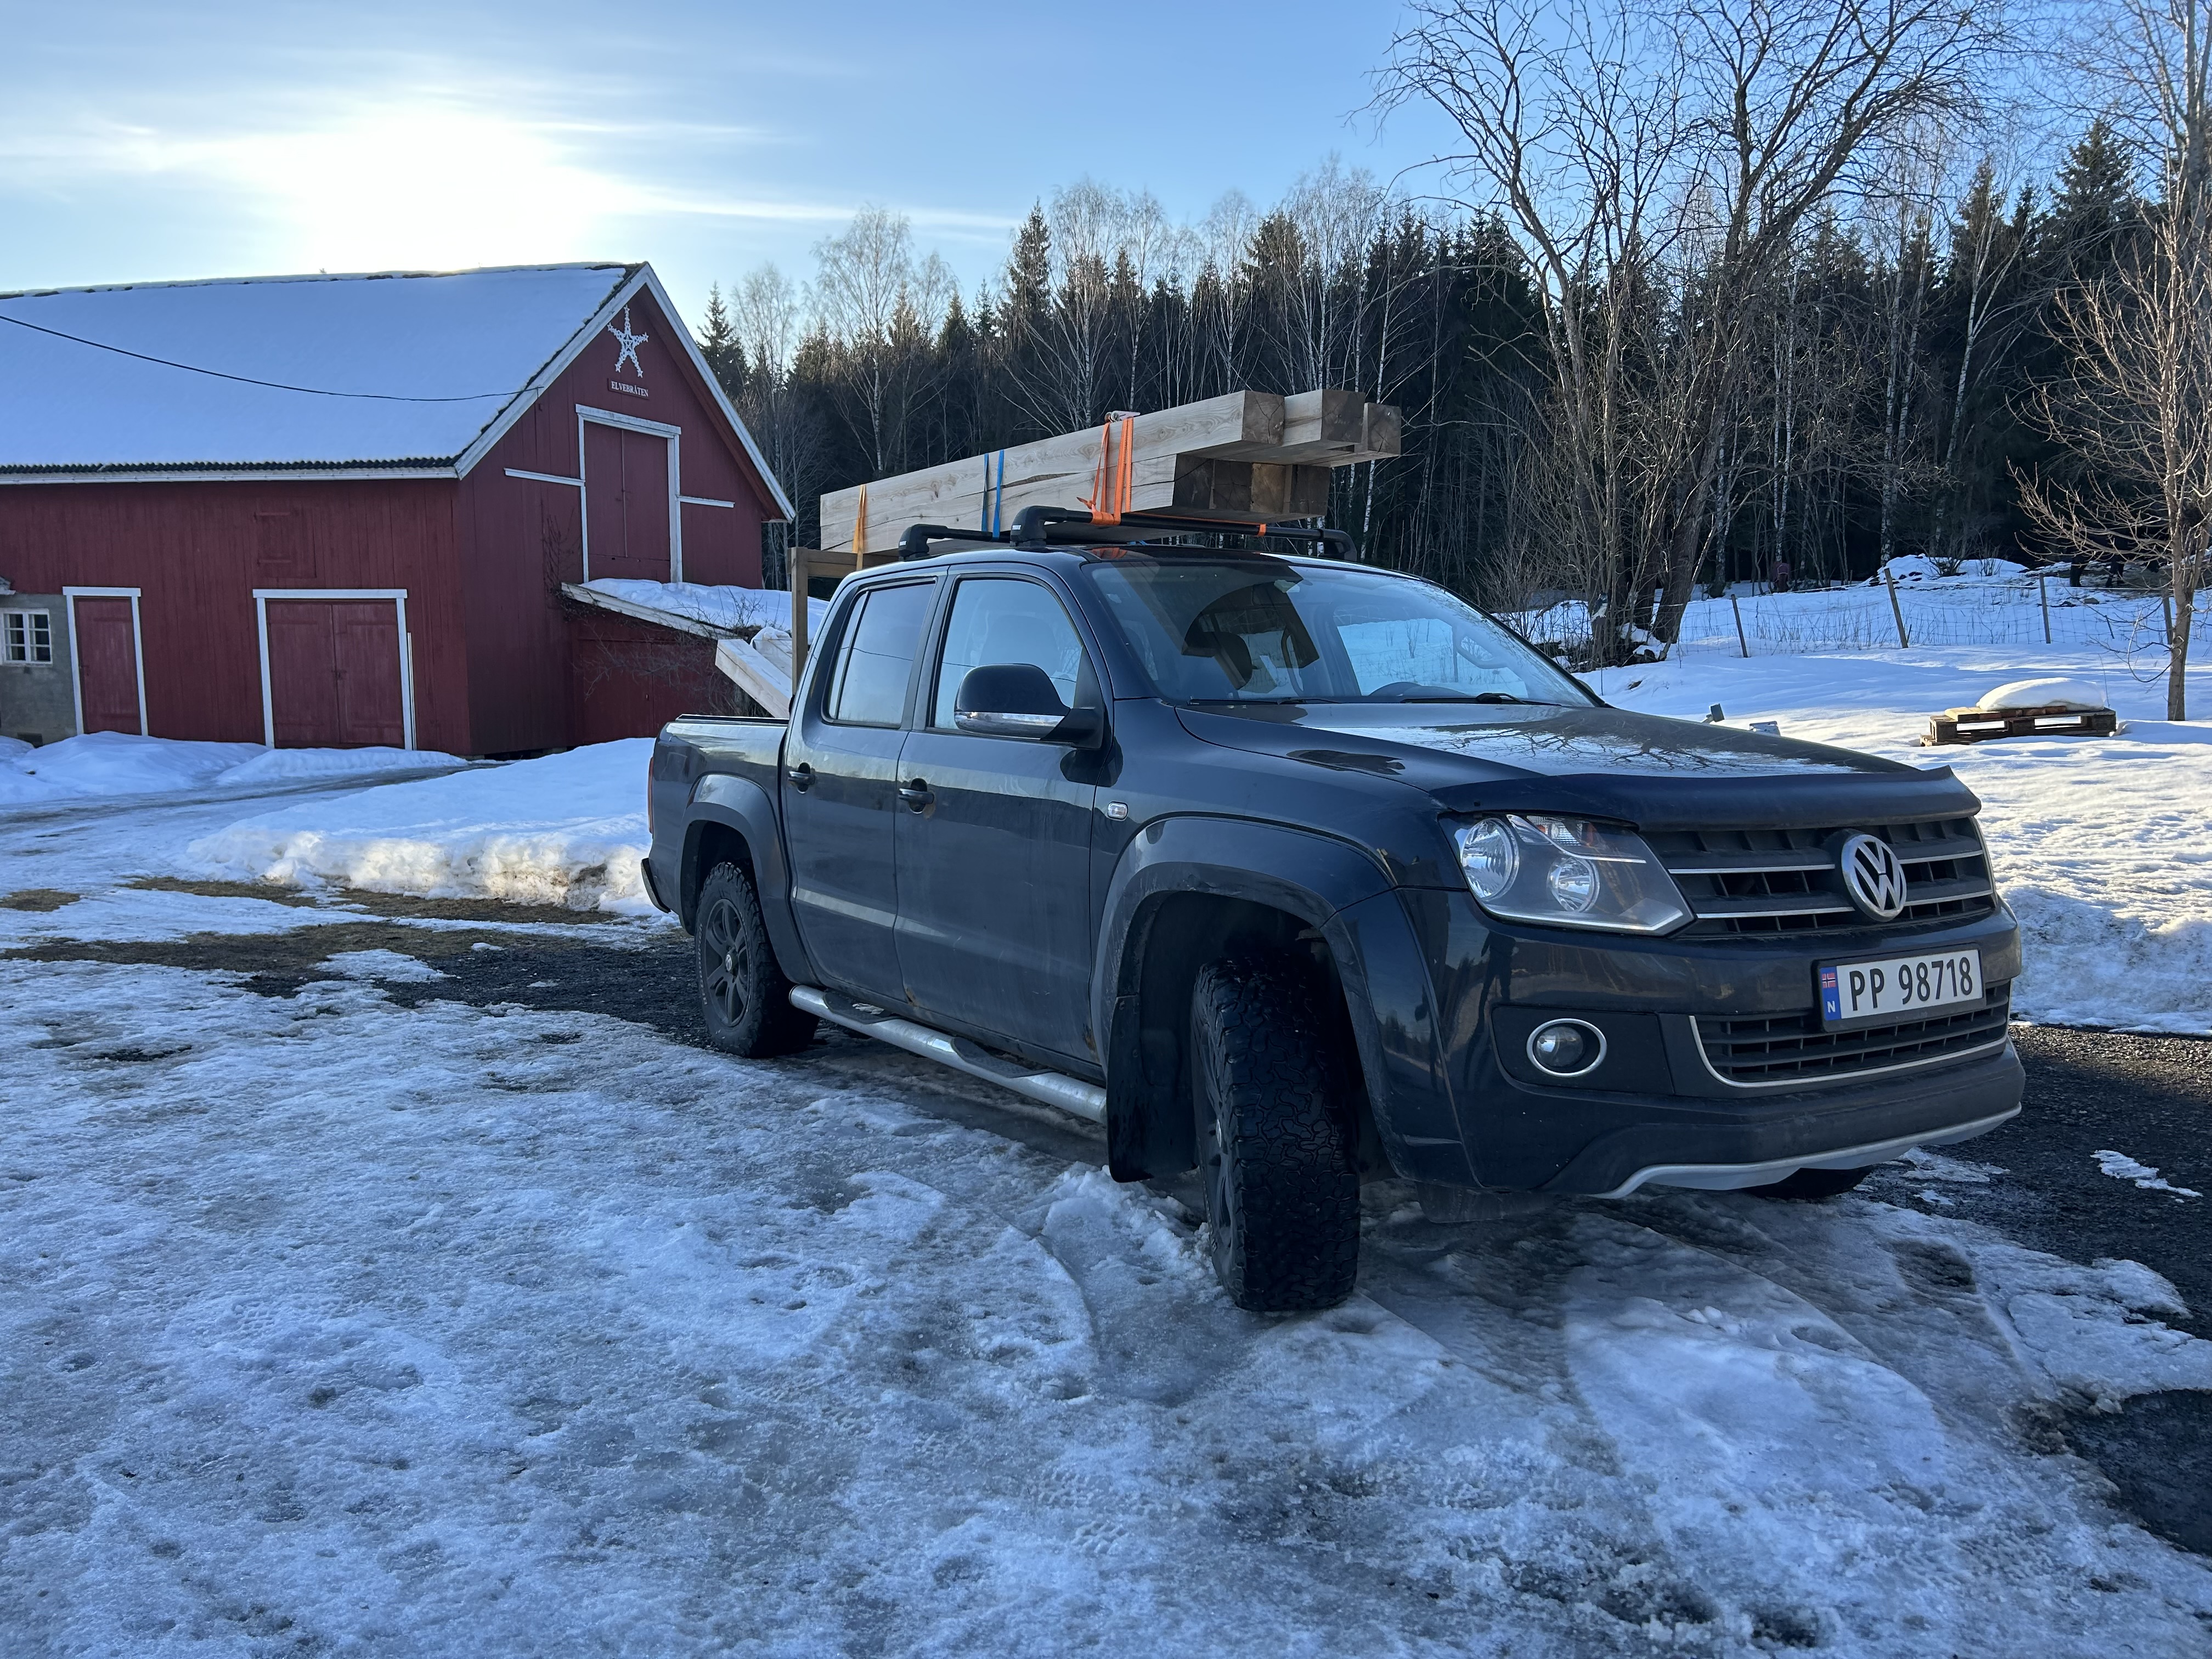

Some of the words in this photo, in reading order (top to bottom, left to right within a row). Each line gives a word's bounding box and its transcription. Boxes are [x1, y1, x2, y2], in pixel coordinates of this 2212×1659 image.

[611, 381, 648, 397] ELVEBRÅTEN
[1844, 836, 1906, 919] VW
[1849, 968, 1884, 1011] PP
[1898, 957, 1973, 1005] 98718
[1826, 1001, 1836, 1013] N
